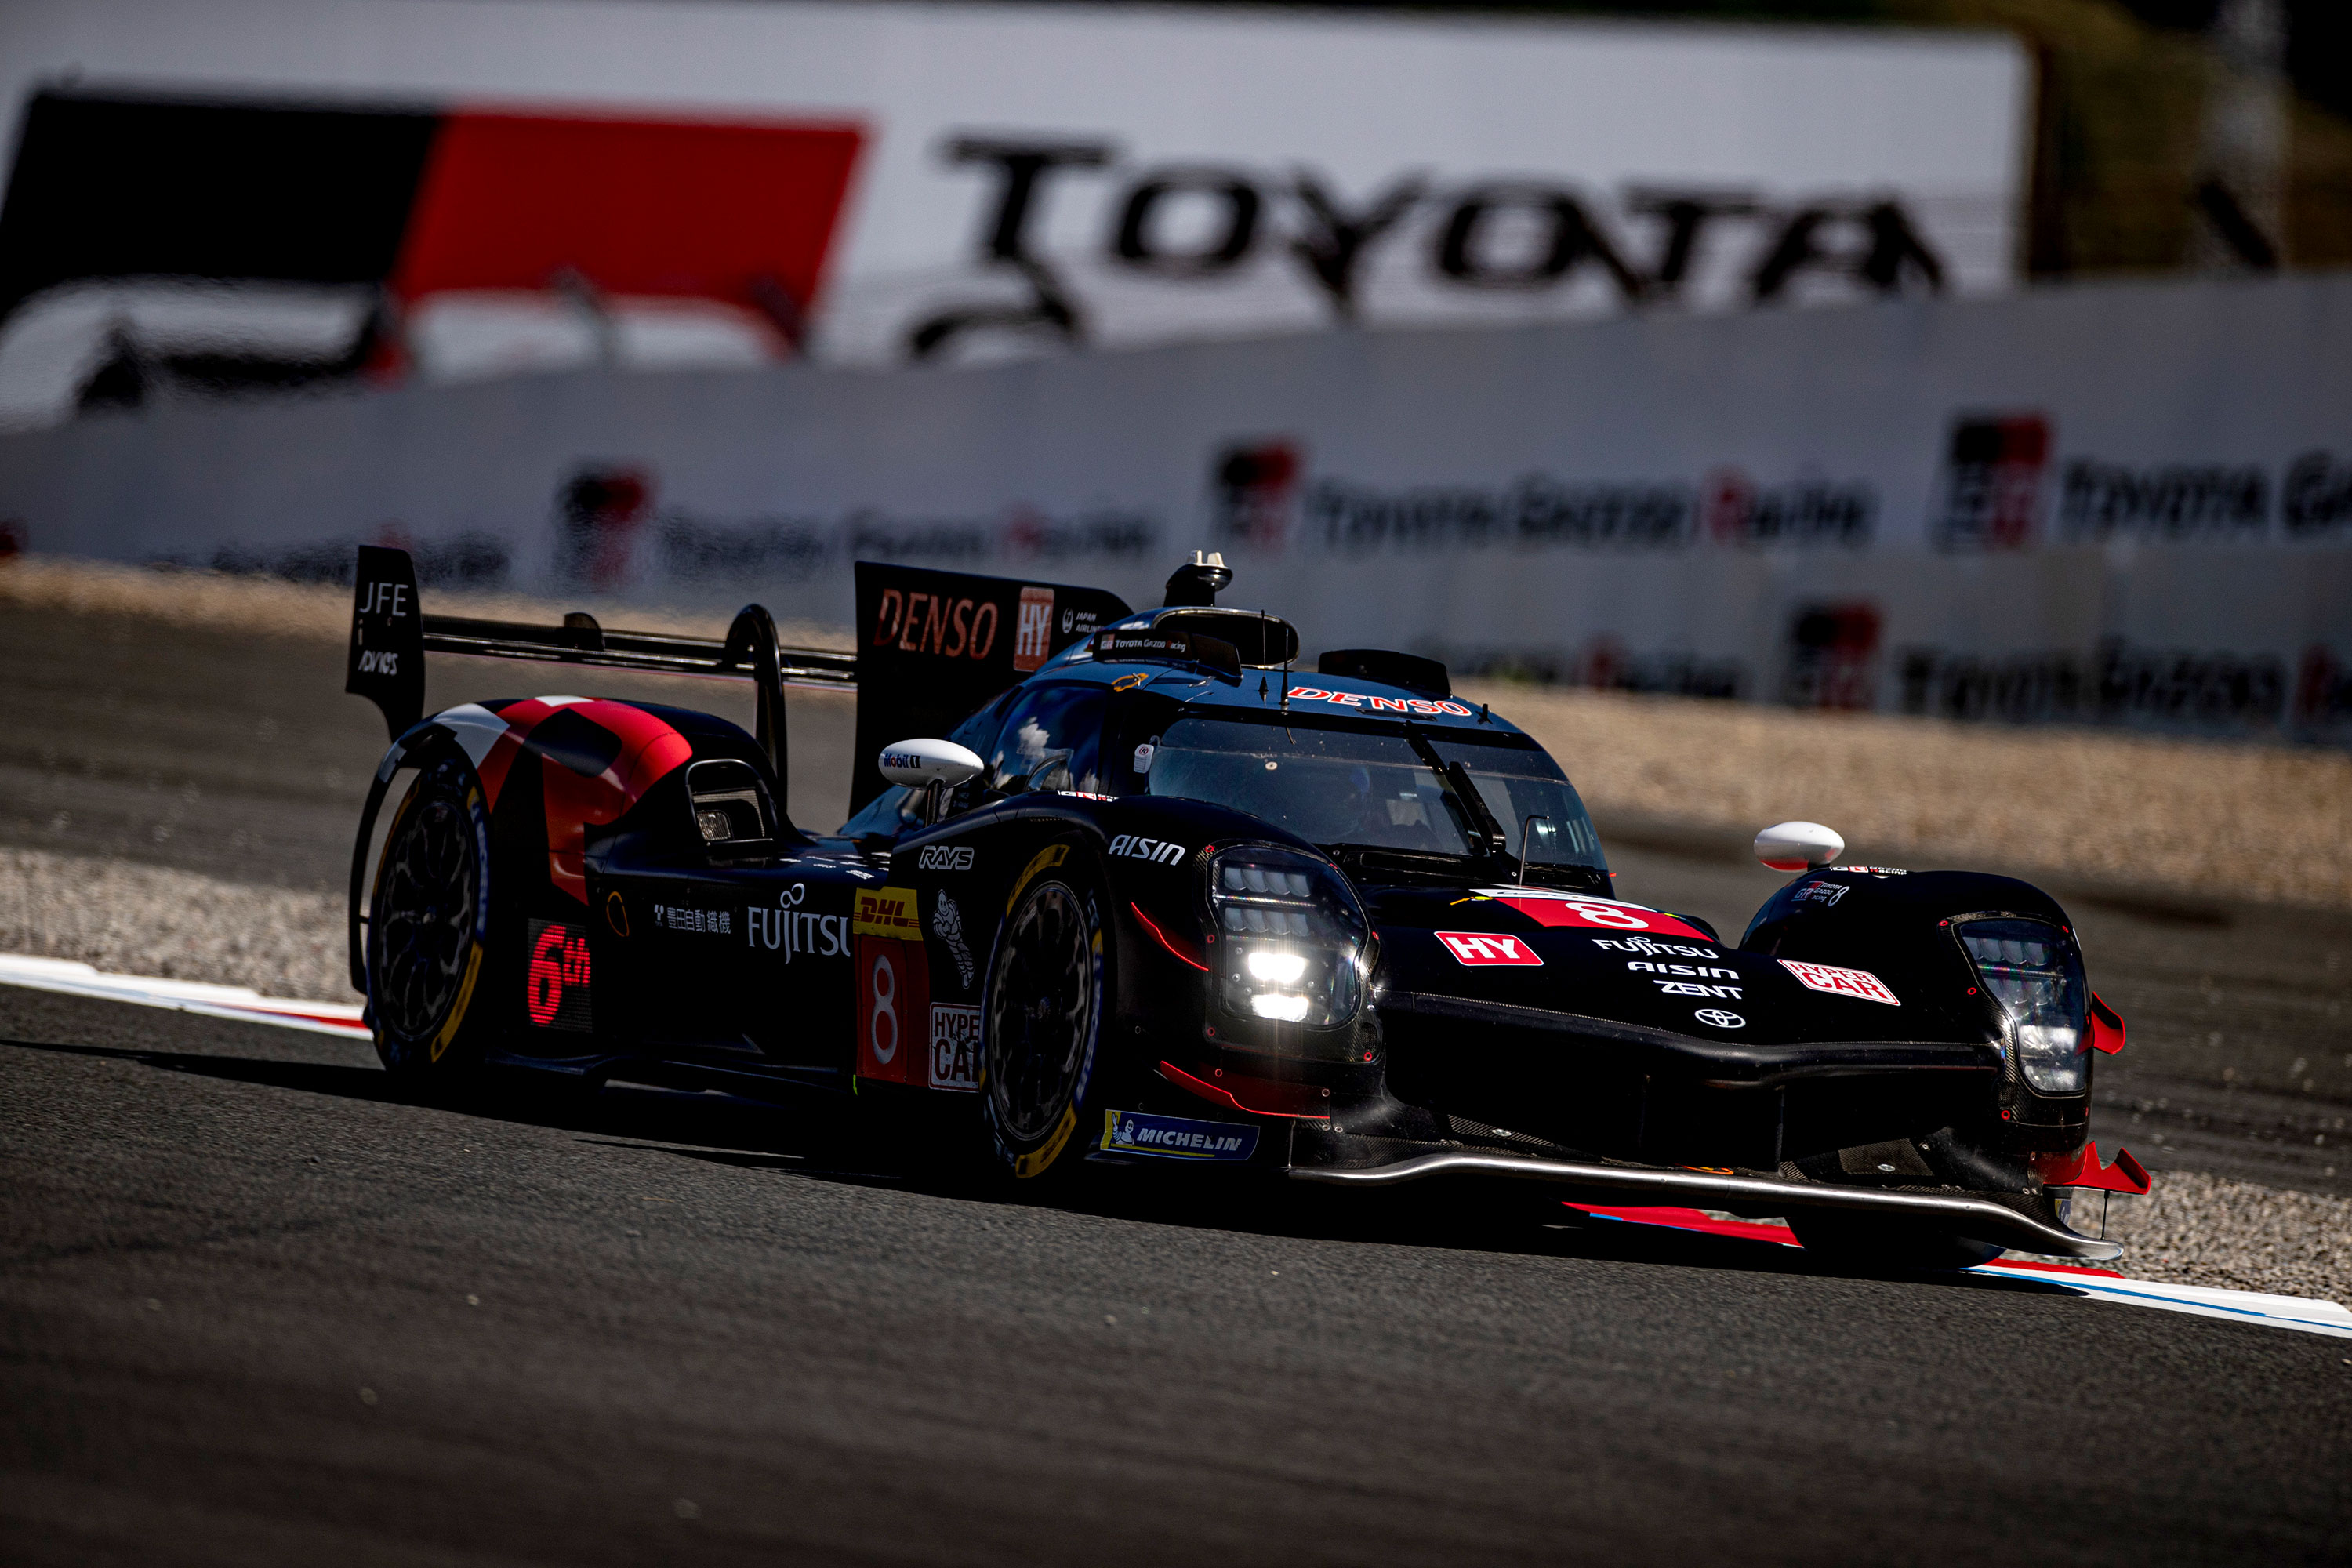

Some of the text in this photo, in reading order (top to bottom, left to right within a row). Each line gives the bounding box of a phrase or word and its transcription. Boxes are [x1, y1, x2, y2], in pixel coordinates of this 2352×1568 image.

[941, 135, 1948, 306] TOYOTA
[358, 581, 408, 617] JFE
[873, 587, 1000, 659] DENSO
[1075, 612, 1097, 622] JAPAN
[1018, 604, 1051, 657] HY
[1116, 639, 1142, 648] TOYOTA
[1287, 687, 1472, 717] DENSO
[884, 753, 909, 768] Mobil
[919, 845, 975, 870] RAYS
[1108, 833, 1185, 866] AISIN
[1828, 886, 1850, 907] 8
[861, 896, 906, 927] DHL
[1565, 902, 1649, 929] 8
[1445, 936, 1524, 959] HY
[1592, 936, 1719, 959] FUJITSU
[1627, 961, 1739, 980] AISIN
[1789, 963, 1871, 982] HYPER
[1653, 980, 1743, 999] ZENT
[1802, 972, 1888, 1000] CAR
[872, 954, 898, 1065] 8
[935, 1012, 980, 1040] HYPE
[1137, 1127, 1242, 1151] MICHELIN
